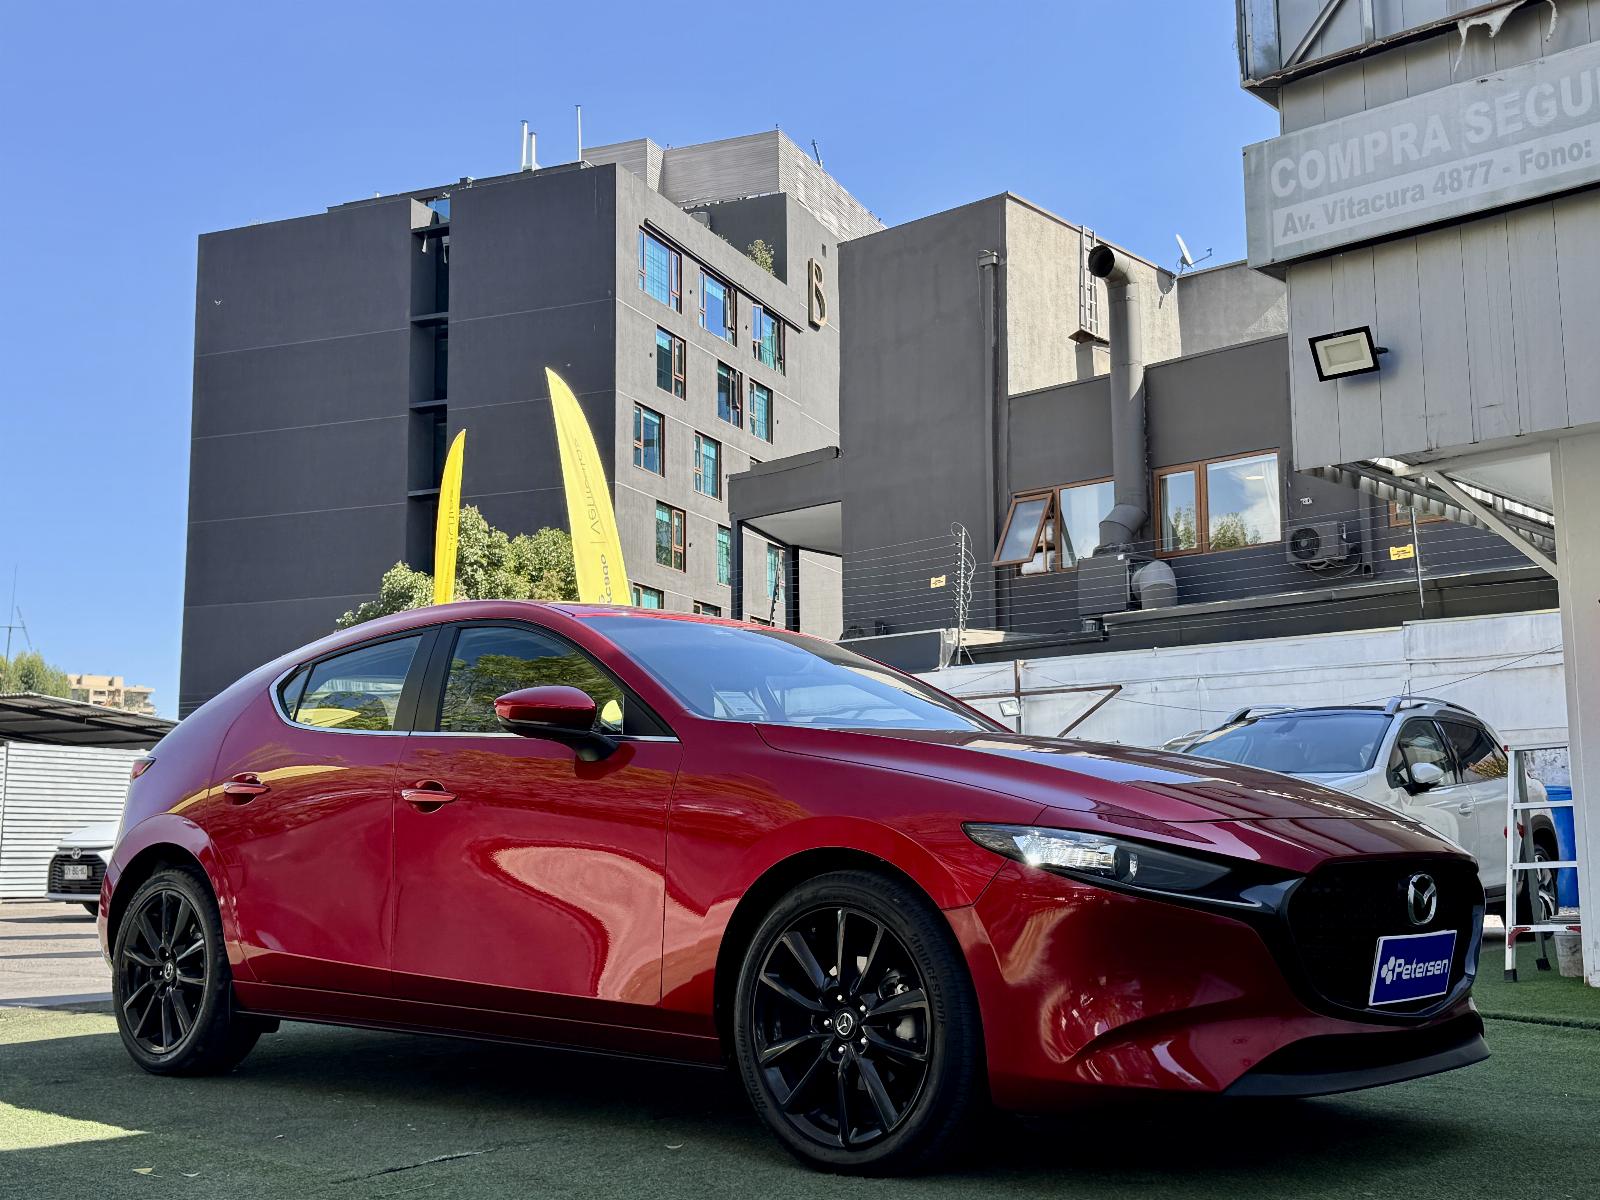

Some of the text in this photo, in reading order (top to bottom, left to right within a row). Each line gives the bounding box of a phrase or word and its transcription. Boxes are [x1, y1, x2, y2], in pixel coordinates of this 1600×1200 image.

[1271, 66, 1600, 198] COMPRA SEGU
[1282, 212, 1315, 238] Av.
[1322, 184, 1425, 226] Vitacura
[1432, 159, 1495, 196] 4877
[1519, 139, 1592, 175] Fono:
[1394, 958, 1449, 981] Petersen
